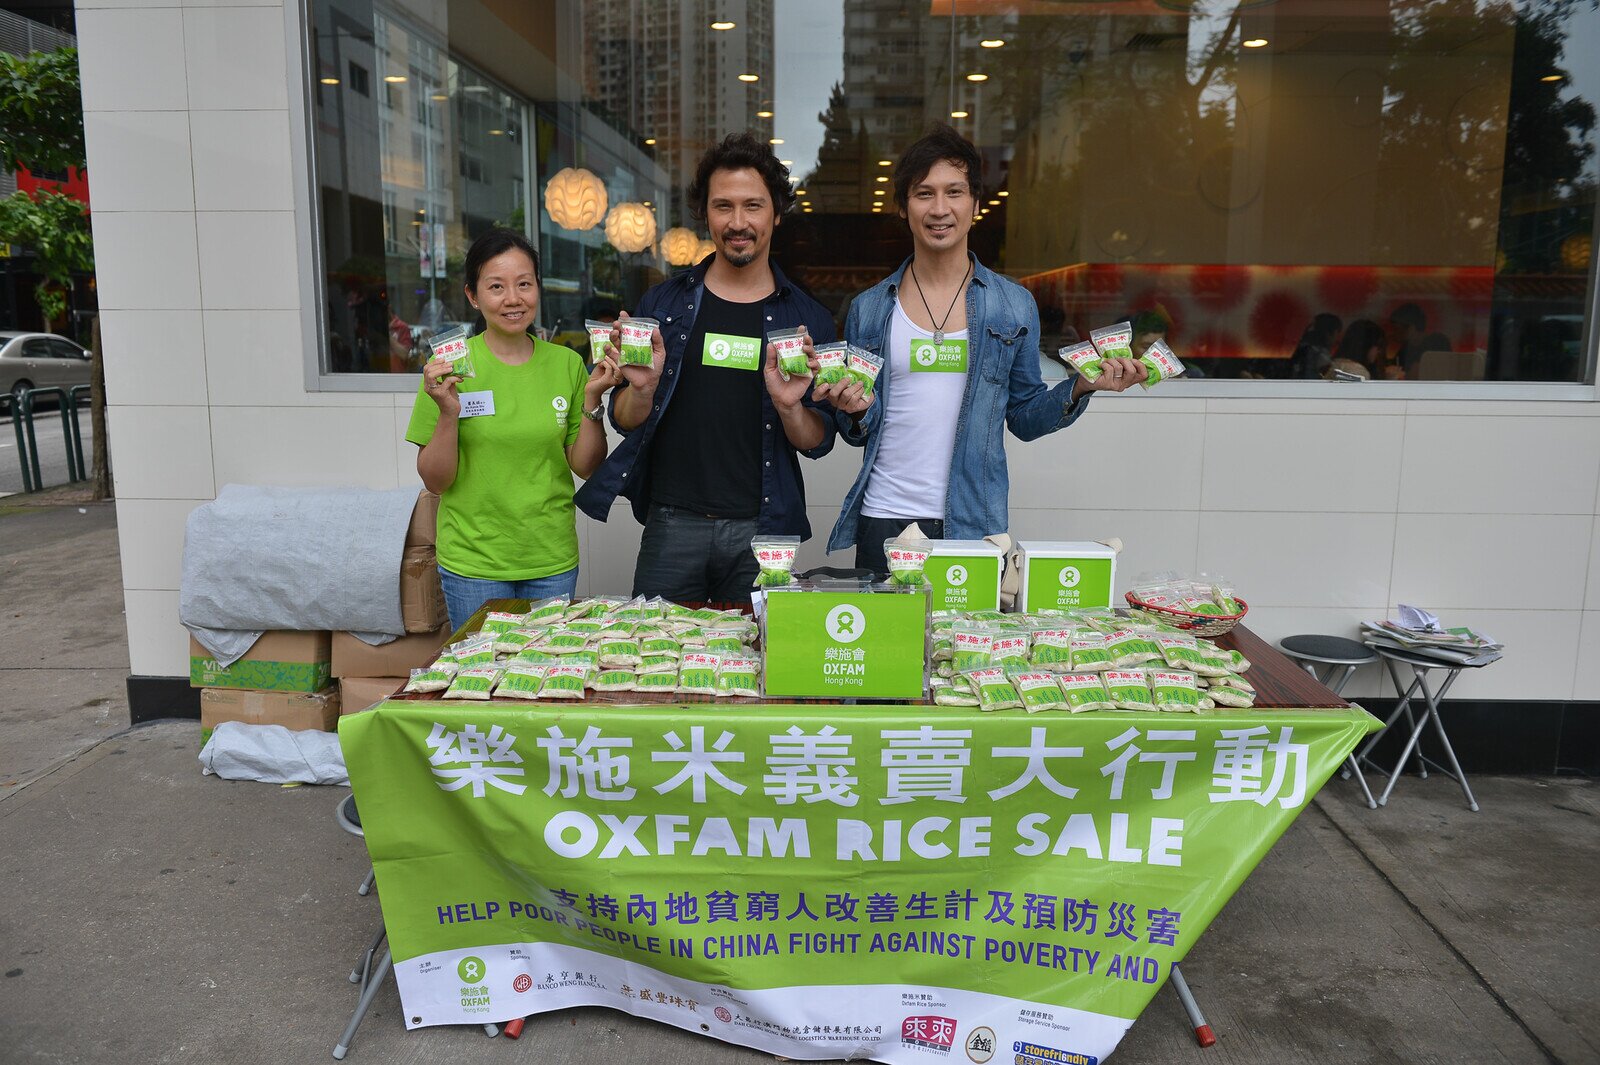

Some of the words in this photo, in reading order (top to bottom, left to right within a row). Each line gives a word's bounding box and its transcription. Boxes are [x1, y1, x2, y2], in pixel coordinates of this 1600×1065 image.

[622, 327, 651, 338] 樂施米
[435, 341, 464, 355] 樂施米
[732, 350, 754, 358] OXFAM
[759, 550, 795, 561] 樂施米
[890, 551, 926, 561] 樂施米
[1058, 589, 1080, 597] 樂施會
[1057, 597, 1080, 605] OXFAM
[956, 634, 990, 644] 樂施米
[992, 639, 1024, 651] 樂施米
[824, 647, 866, 661] 樂施會
[684, 654, 718, 666] 樂施米
[823, 663, 865, 675] OXFAM
[825, 677, 843, 686] Hong
[845, 677, 863, 686] Kong
[1155, 673, 1192, 681] 樂施米
[425, 722, 1309, 810] 樂施米義賣大行動
[543, 810, 811, 858] OXFAM
[836, 816, 992, 861] RICE
[1013, 812, 1185, 867] SALE
[549, 888, 1182, 947] 支持內地貧窮人改善生計及預防災害
[437, 901, 500, 924] HELP
[508, 901, 570, 926] POOR
[573, 917, 662, 954] PEOPLE
[669, 937, 693, 959] IN
[703, 933, 780, 959] CHINA
[789, 932, 861, 954] FIGHT
[869, 931, 976, 959] AGAINST
[985, 938, 1100, 974] POVERTY
[1105, 953, 1159, 984] AND
[419, 965, 442, 974] Organiser
[546, 970, 598, 984] 永亨銀行
[460, 985, 489, 997] 樂施會
[537, 982, 559, 990] BANCO
[461, 996, 491, 1007] OXFAM
[1018, 1016, 1034, 1024] Storage
[1034, 1019, 1051, 1028] Service
[1051, 1022, 1070, 1031] Sponsor
